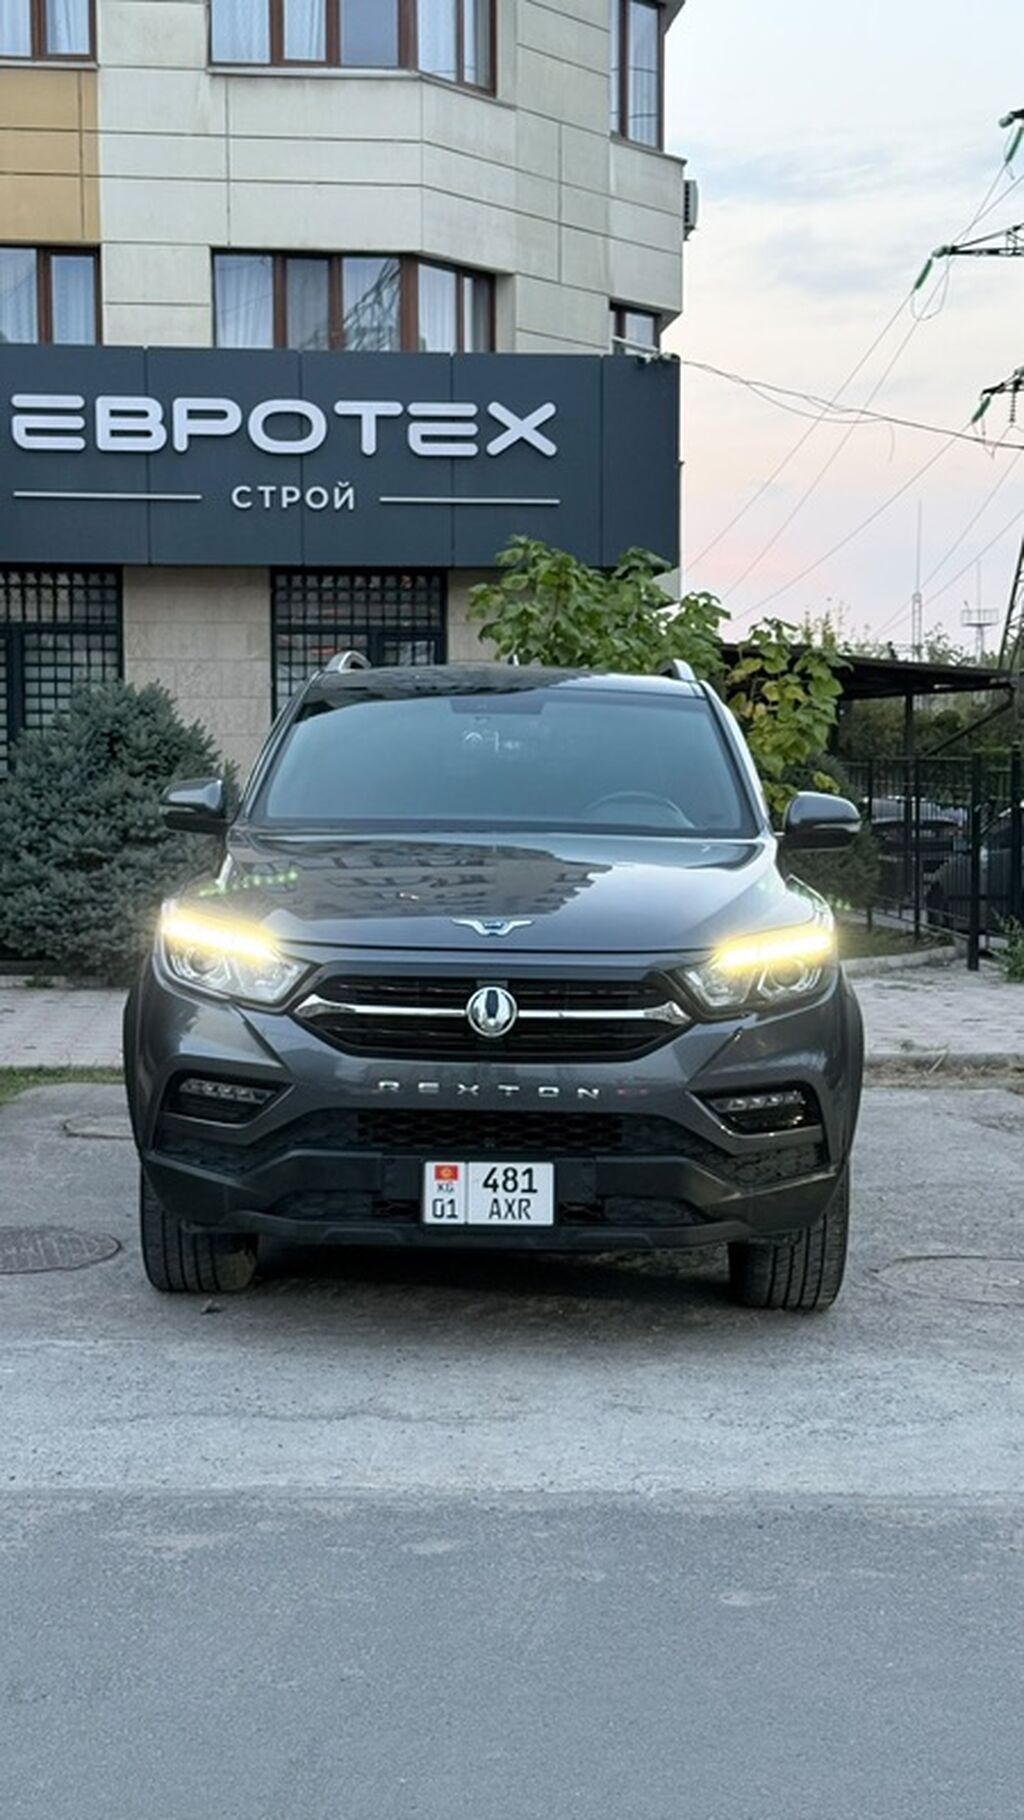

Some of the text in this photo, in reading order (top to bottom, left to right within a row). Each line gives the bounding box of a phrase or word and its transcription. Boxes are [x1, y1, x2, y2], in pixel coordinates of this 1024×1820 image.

[11, 394, 558, 457] ЕВРОТЕХ
[231, 481, 355, 511] СТРОЙ
[378, 1080, 600, 1099] REXTON
[482, 1166, 538, 1194] 481
[432, 1198, 458, 1219] 01
[488, 1198, 532, 1220] AXR
